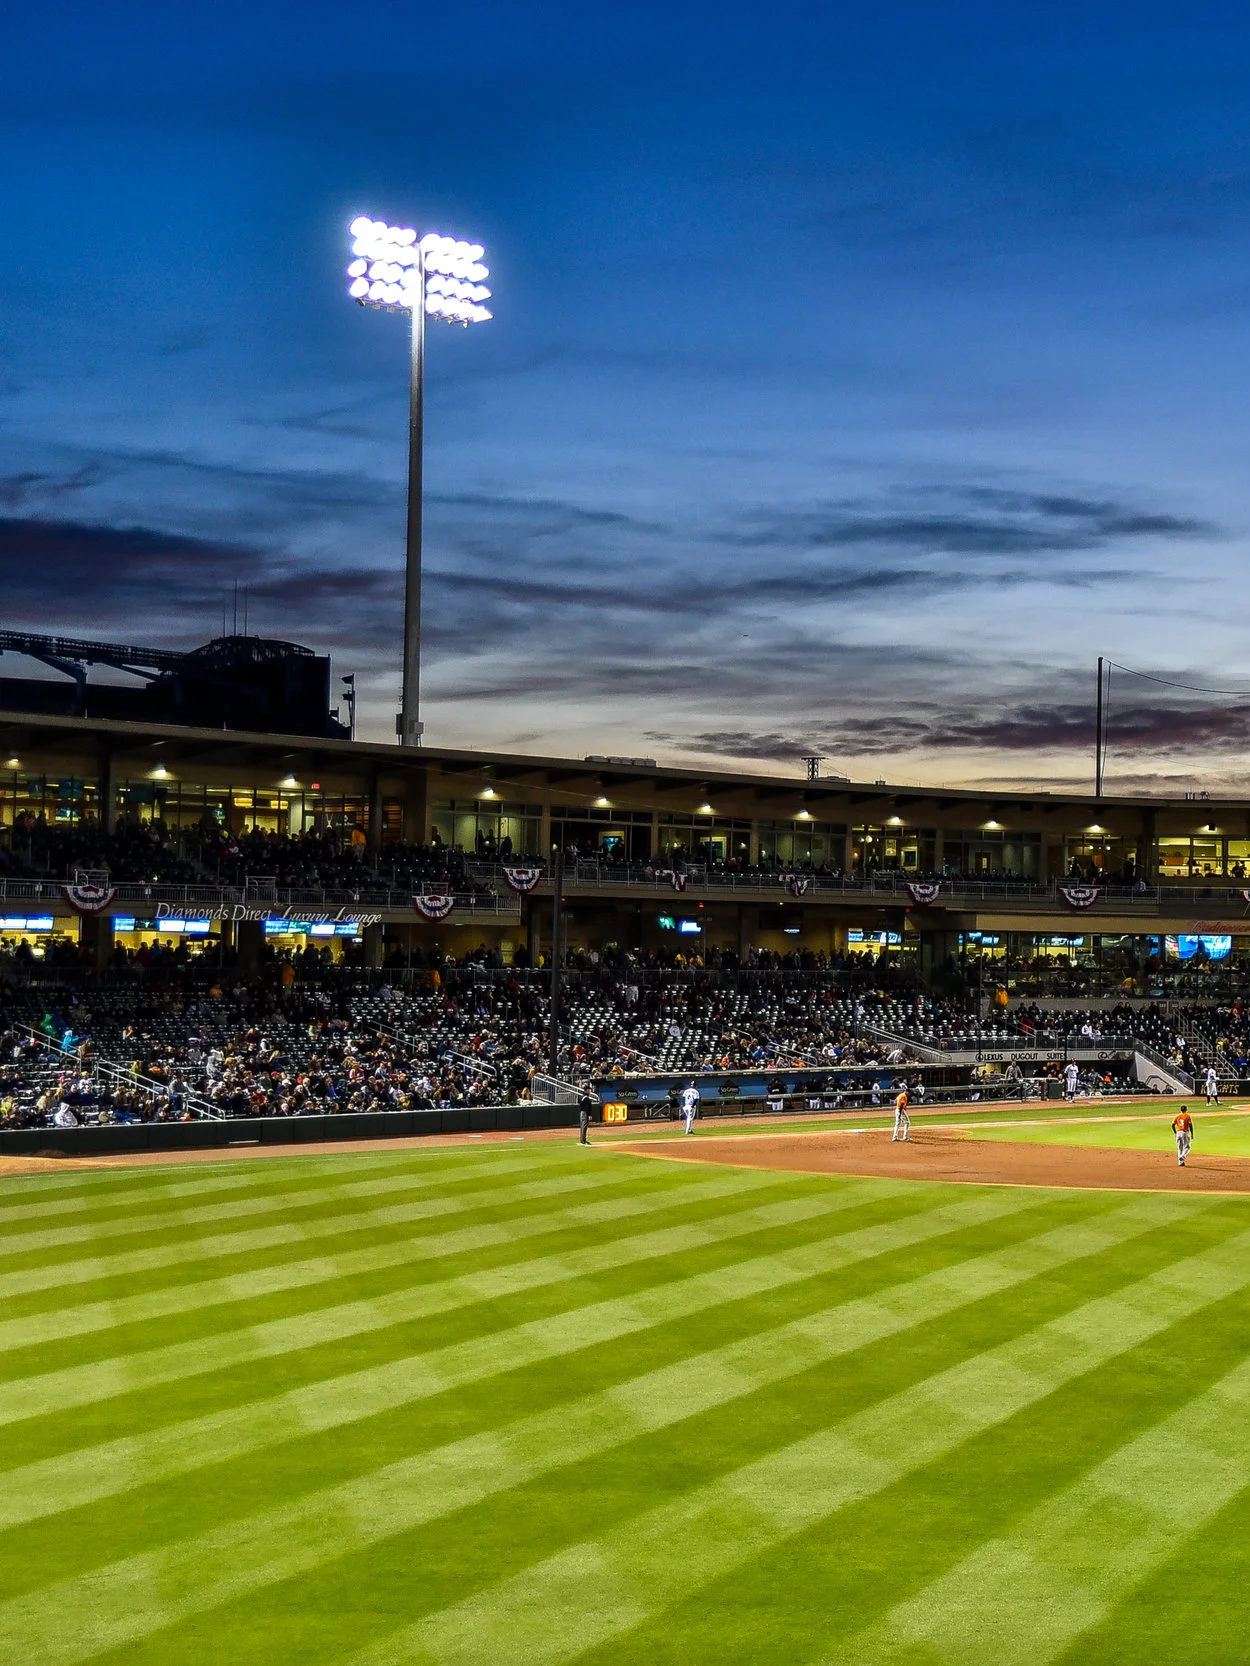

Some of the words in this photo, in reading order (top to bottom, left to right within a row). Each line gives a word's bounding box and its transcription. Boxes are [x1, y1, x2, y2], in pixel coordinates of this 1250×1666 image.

[155, 902, 229, 921] Diamonds
[231, 904, 272, 921] Direct
[277, 905, 330, 927] Luxury
[329, 906, 382, 928] Lounge
[985, 1053, 1004, 1061] LEXUS
[1010, 1052, 1039, 1061] DUGOUT
[1200, 1084, 1240, 1095] KGHTS
